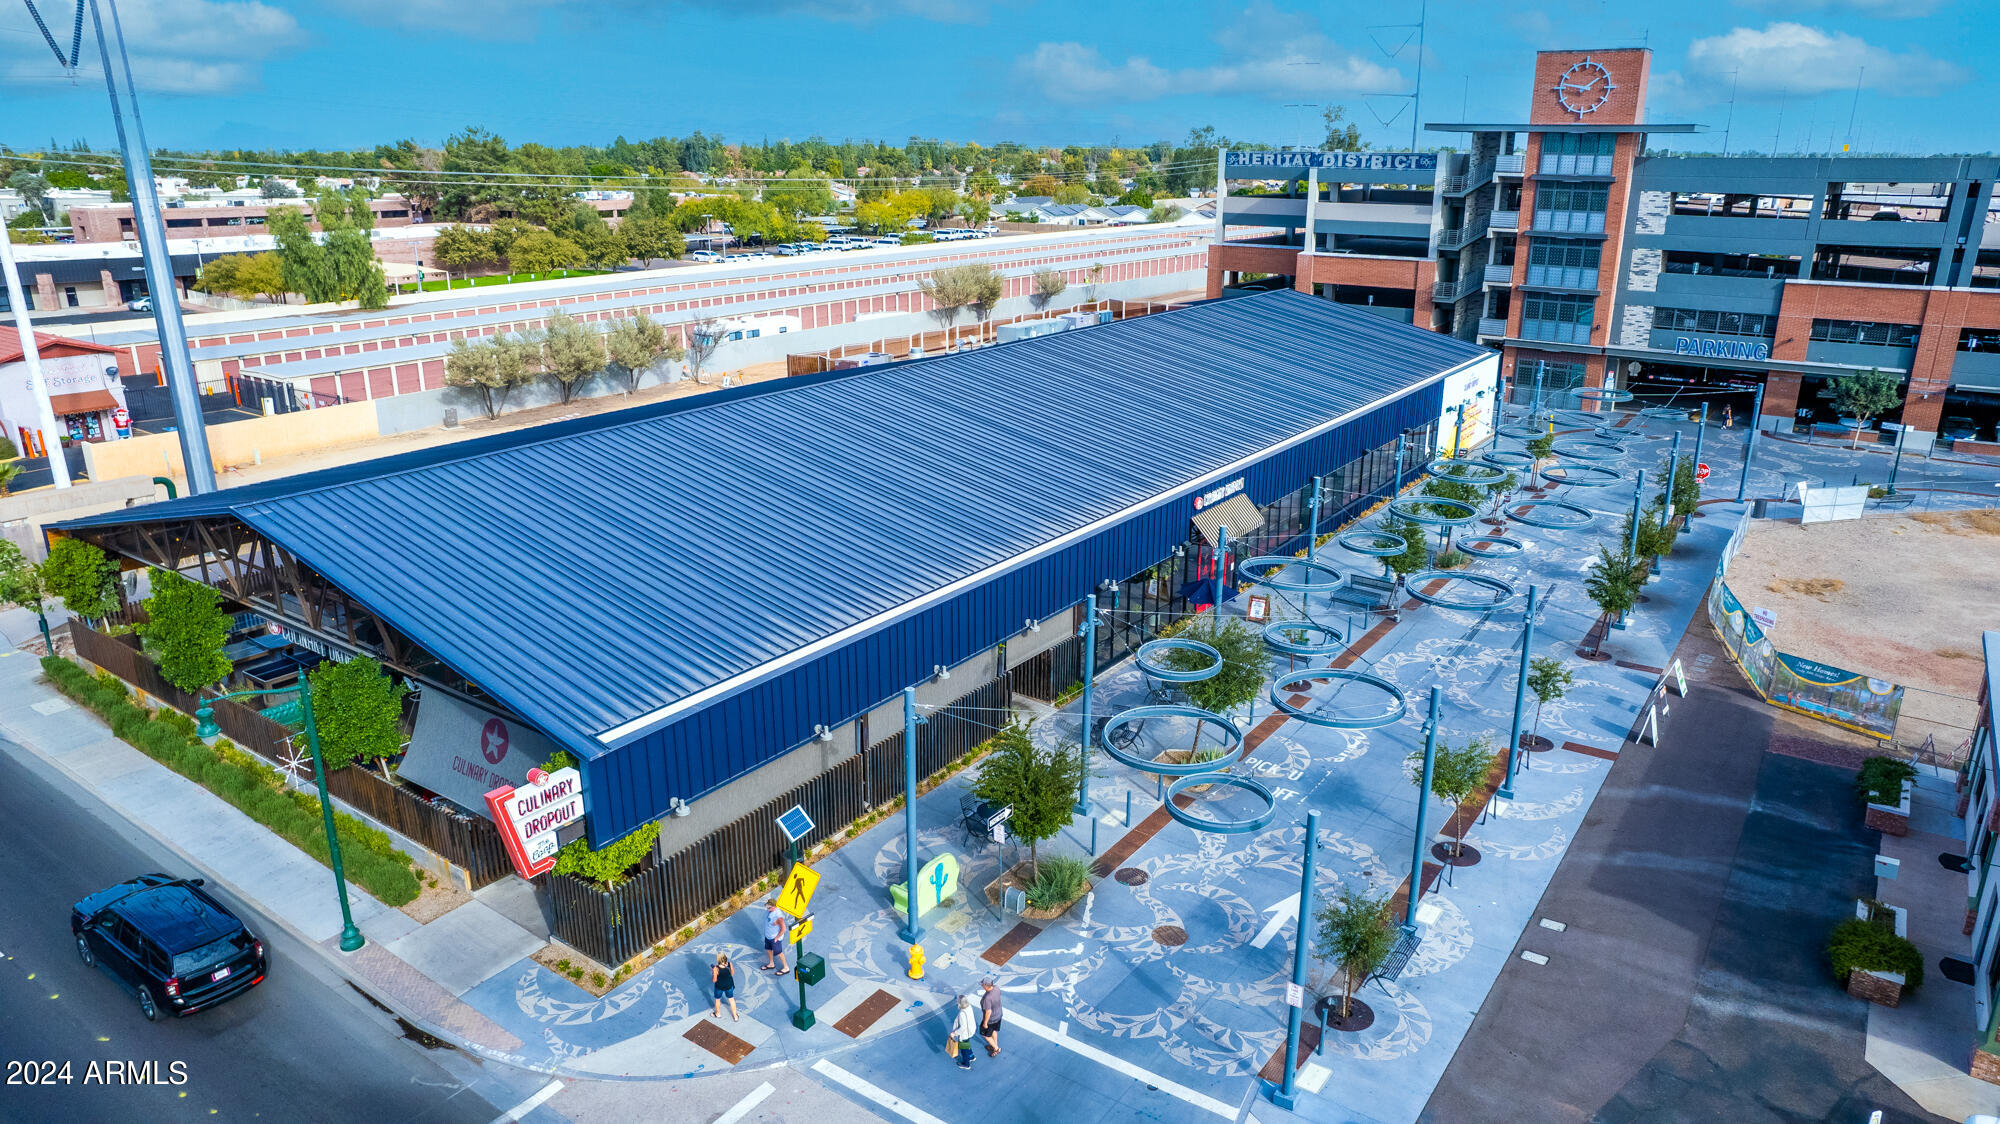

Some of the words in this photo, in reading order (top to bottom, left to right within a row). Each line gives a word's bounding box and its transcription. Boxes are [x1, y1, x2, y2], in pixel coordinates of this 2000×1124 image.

[1322, 153, 1420, 169] DISTRICT
[1675, 336, 1768, 361] PARKING
[53, 374, 96, 387] Storage
[1796, 661, 1812, 670] New
[1813, 665, 1841, 678] Homes!
[452, 755, 489, 784] CULINARY
[1245, 756, 1280, 775] PICK
[517, 777, 574, 816] CULINARY
[1271, 786, 1300, 801] FF
[524, 800, 576, 839] DROPOUT
